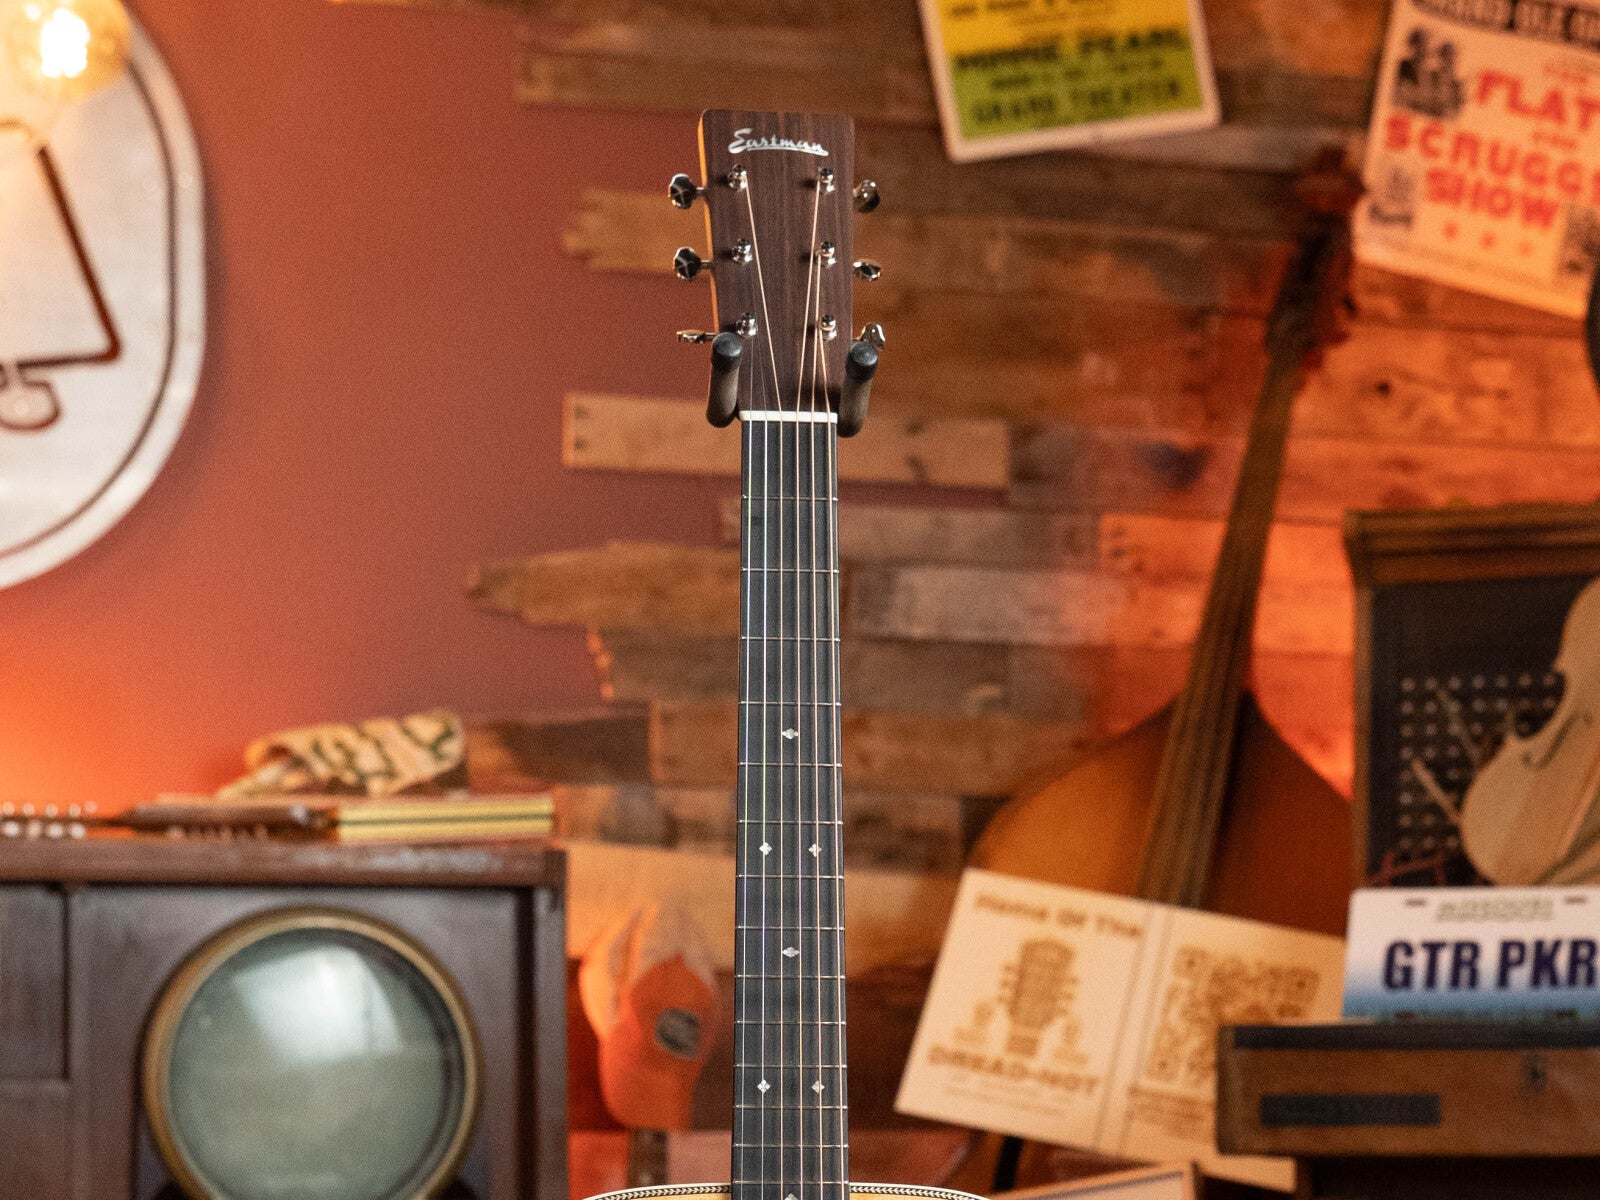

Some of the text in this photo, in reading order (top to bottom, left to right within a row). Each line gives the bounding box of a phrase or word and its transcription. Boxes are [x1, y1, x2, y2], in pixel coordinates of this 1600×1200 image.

[728, 128, 829, 157] Eastman
[1424, 166, 1561, 232] SHOW
[1382, 937, 1599, 992] GTR PKR
